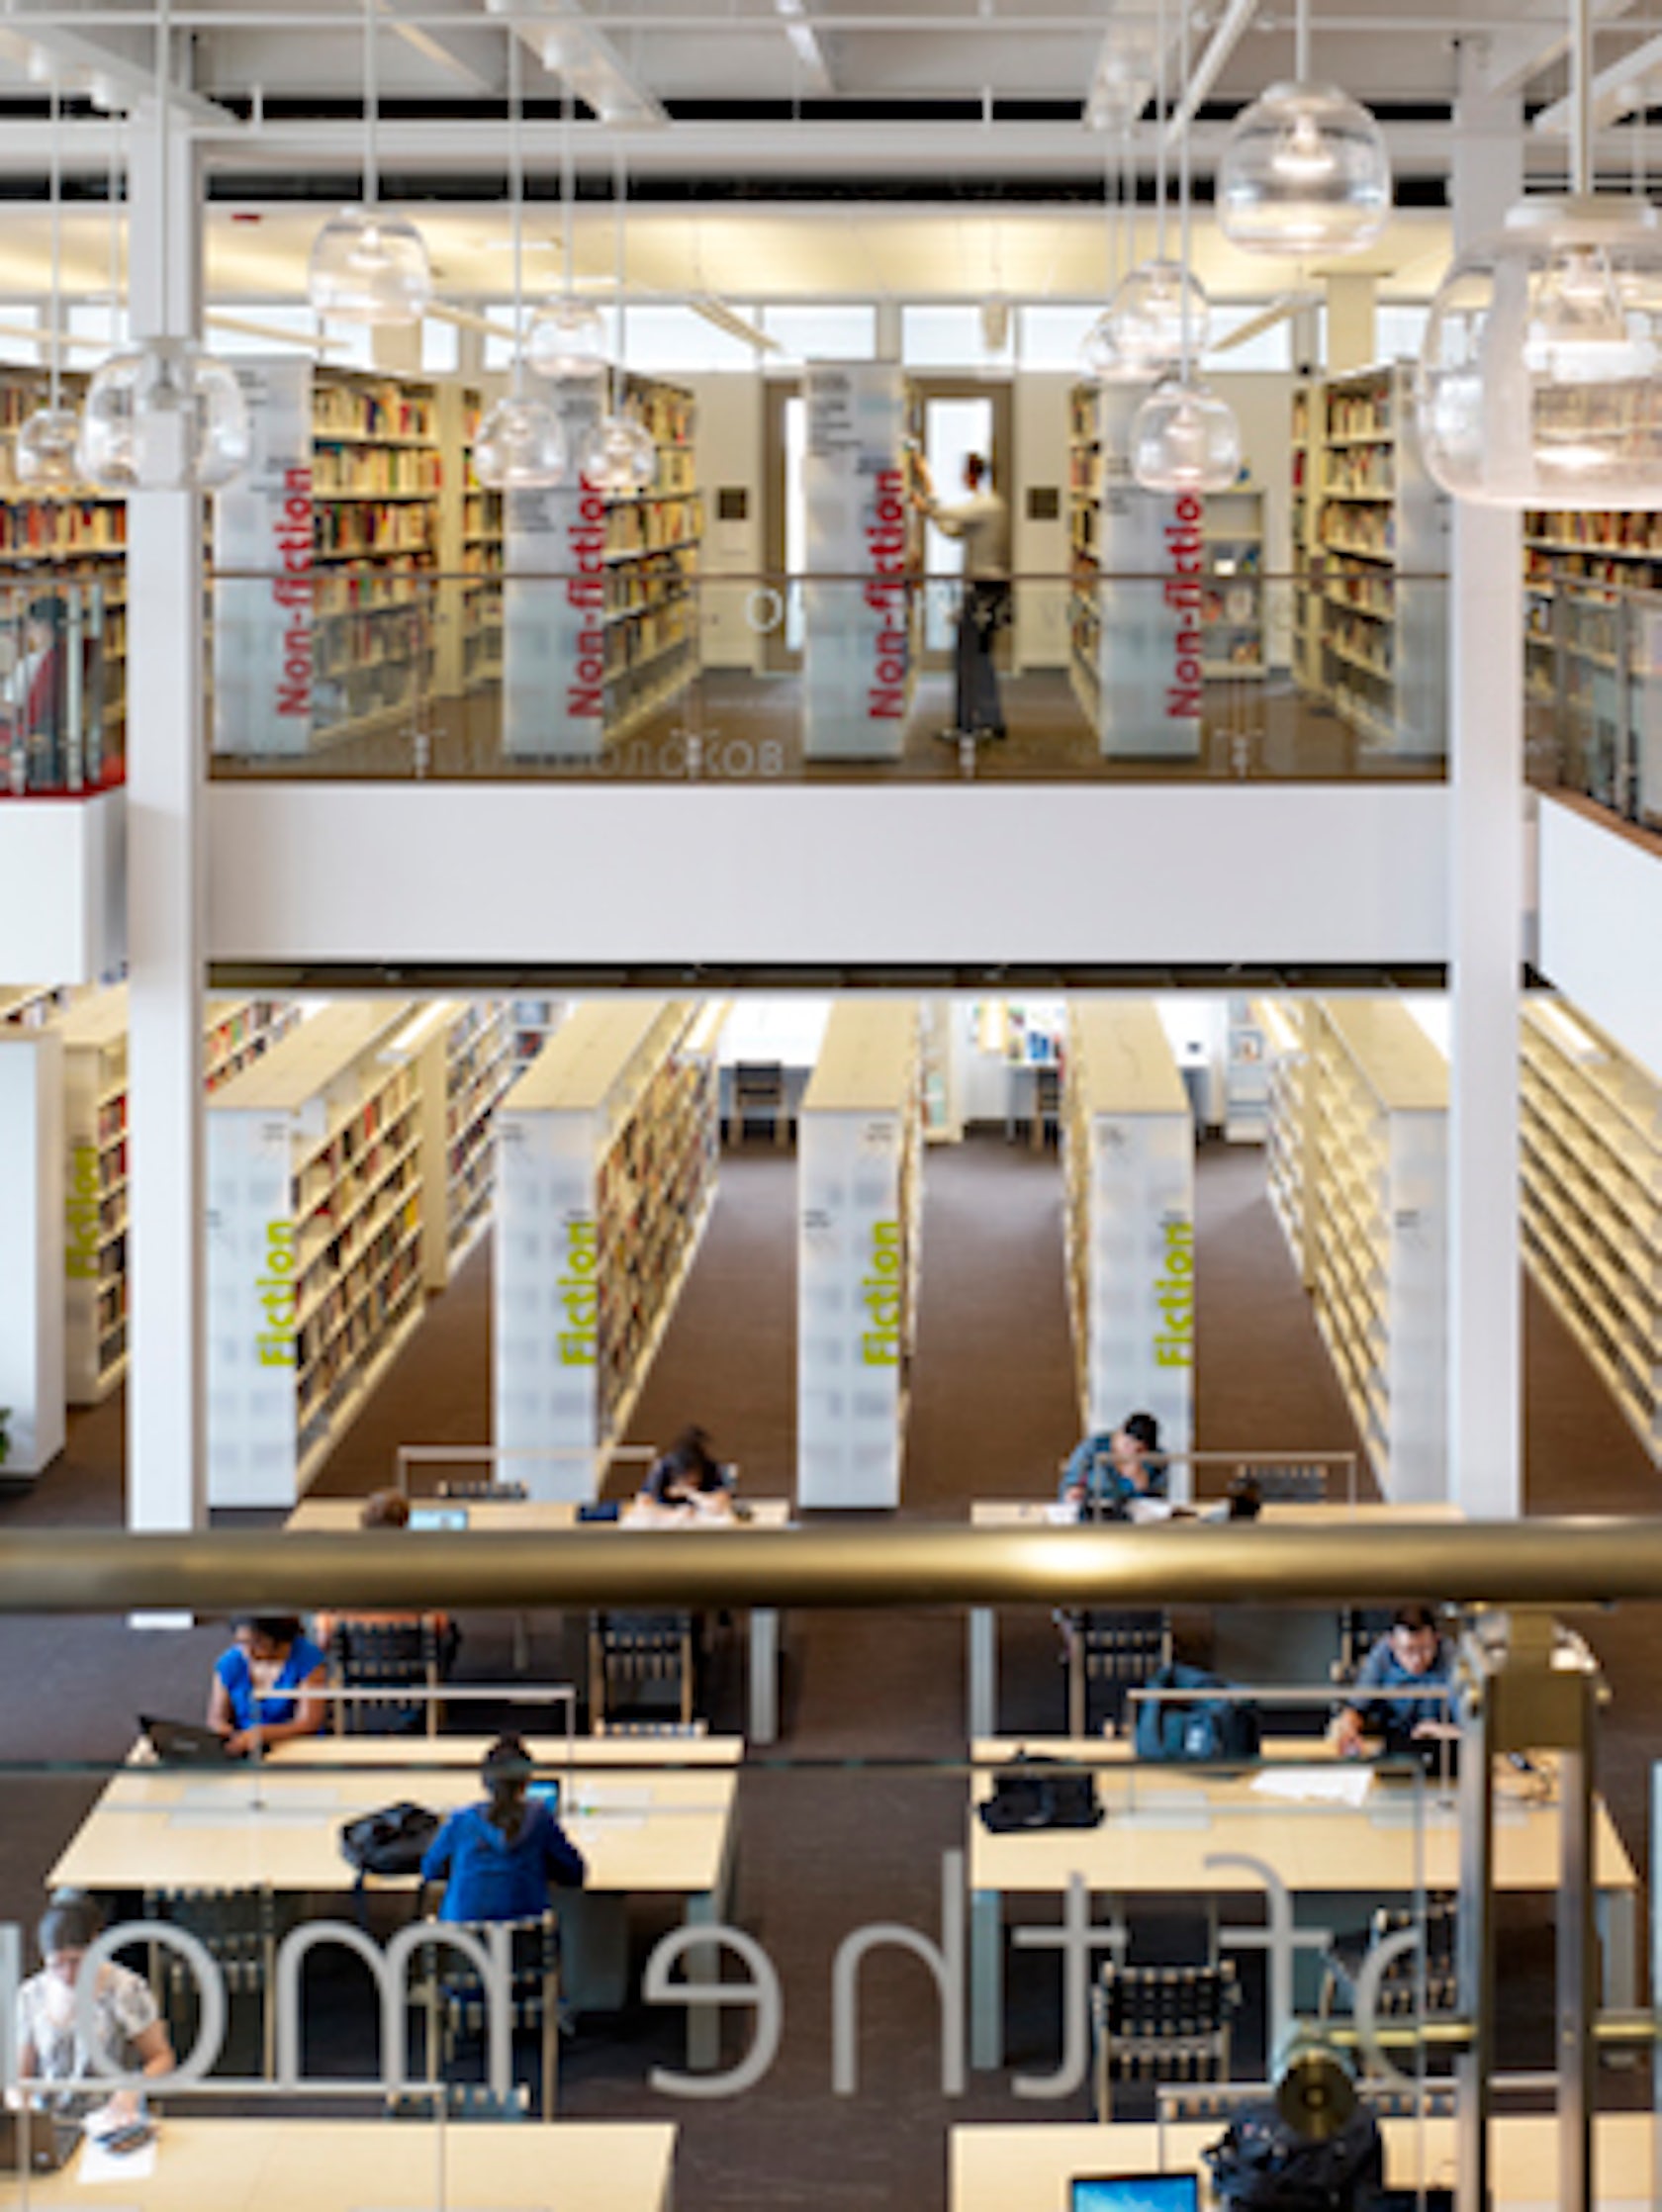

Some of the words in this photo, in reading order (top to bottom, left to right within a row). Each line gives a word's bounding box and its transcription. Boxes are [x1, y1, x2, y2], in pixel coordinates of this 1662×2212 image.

[273, 468, 313, 715] Non-fiction
[864, 468, 905, 719] Non-fiction
[1163, 486, 1204, 717] Non-fictio
[255, 1220, 296, 1366] Fiction
[557, 1220, 598, 1366] Fiction
[861, 1220, 900, 1366] Fiction
[1154, 1222, 1194, 1367] Fiction
